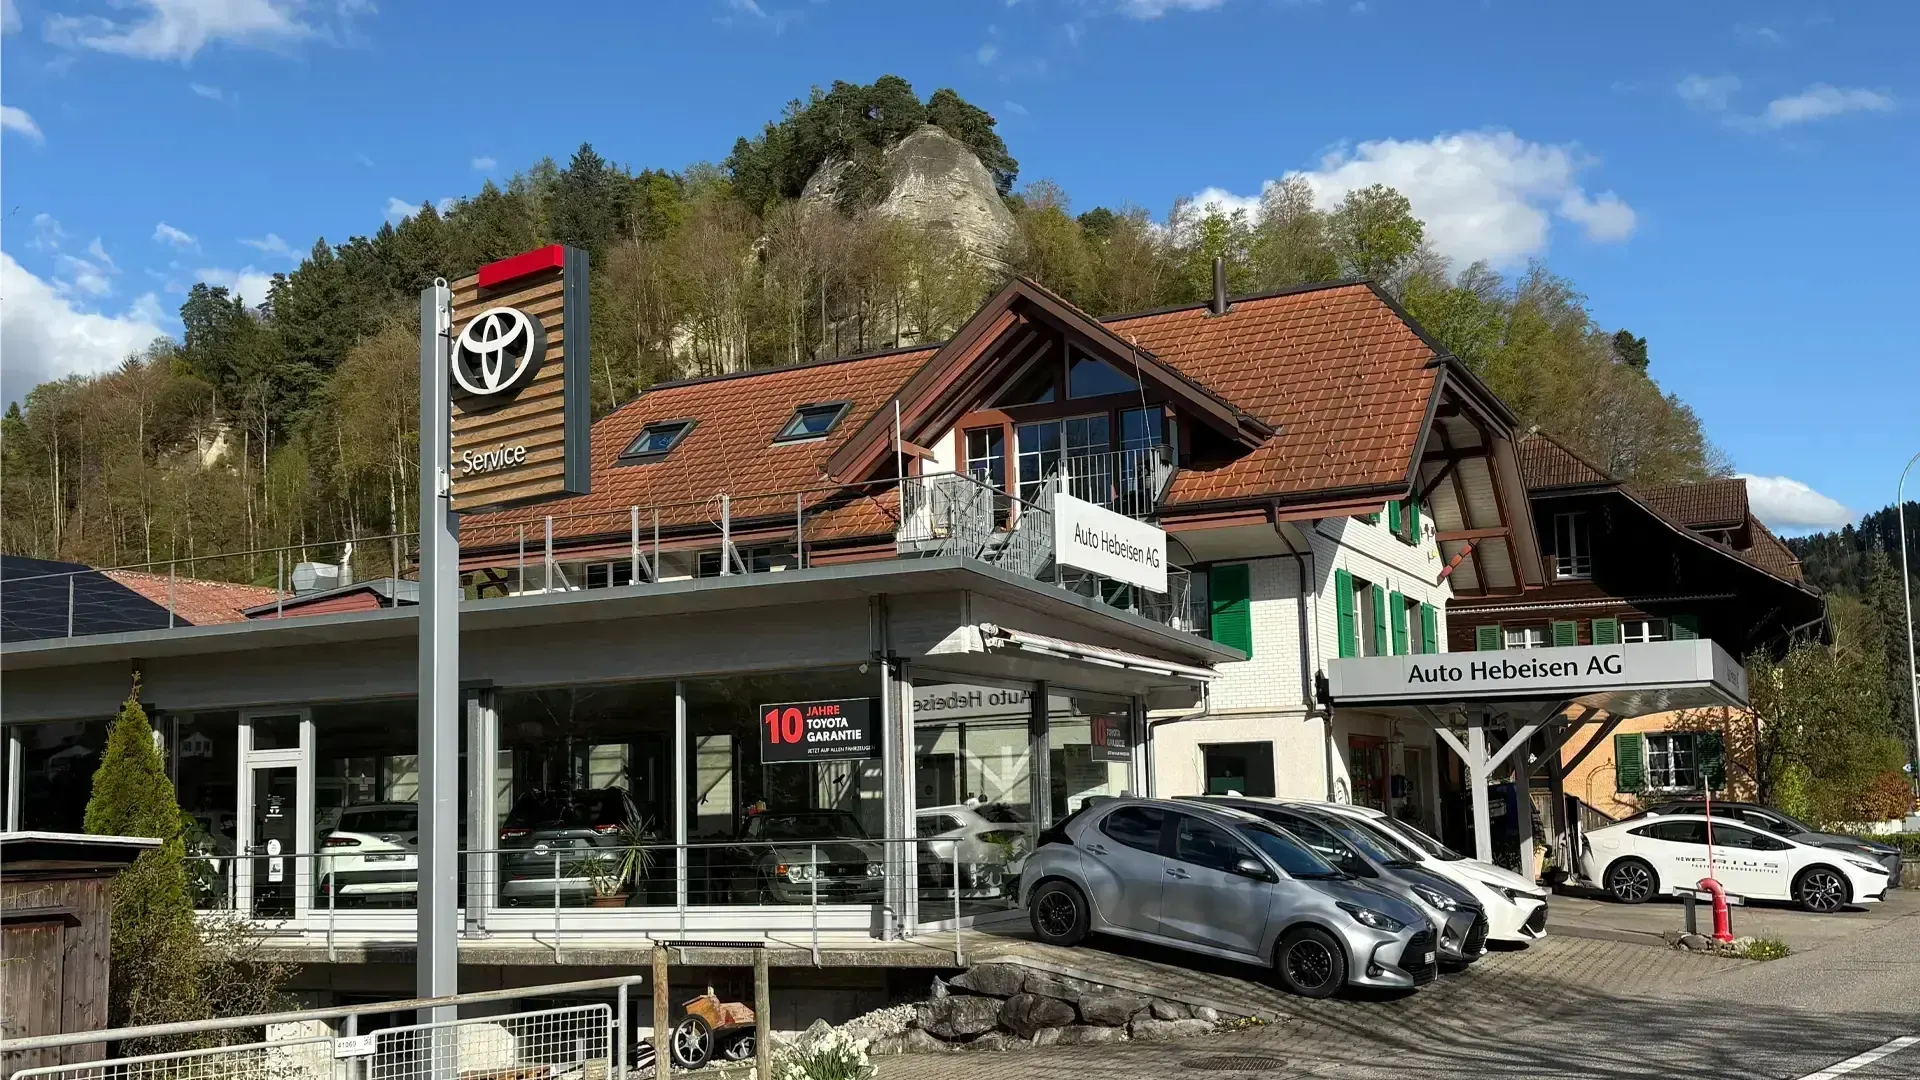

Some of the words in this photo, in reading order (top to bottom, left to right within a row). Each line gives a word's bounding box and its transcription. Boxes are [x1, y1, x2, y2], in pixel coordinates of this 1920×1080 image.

[462, 443, 526, 473] Service
[1074, 521, 1099, 549] Auto
[1101, 530, 1144, 564] Hebeisen
[1146, 546, 1160, 569] AG
[1408, 664, 1463, 683] Auto
[1470, 658, 1578, 681] Hebeisen
[1586, 654, 1623, 676] AG
[765, 707, 804, 744] 10
[806, 705, 840, 717] JAHRE
[806, 717, 849, 729] TOYOTA
[806, 729, 862, 743] GARANTIE
